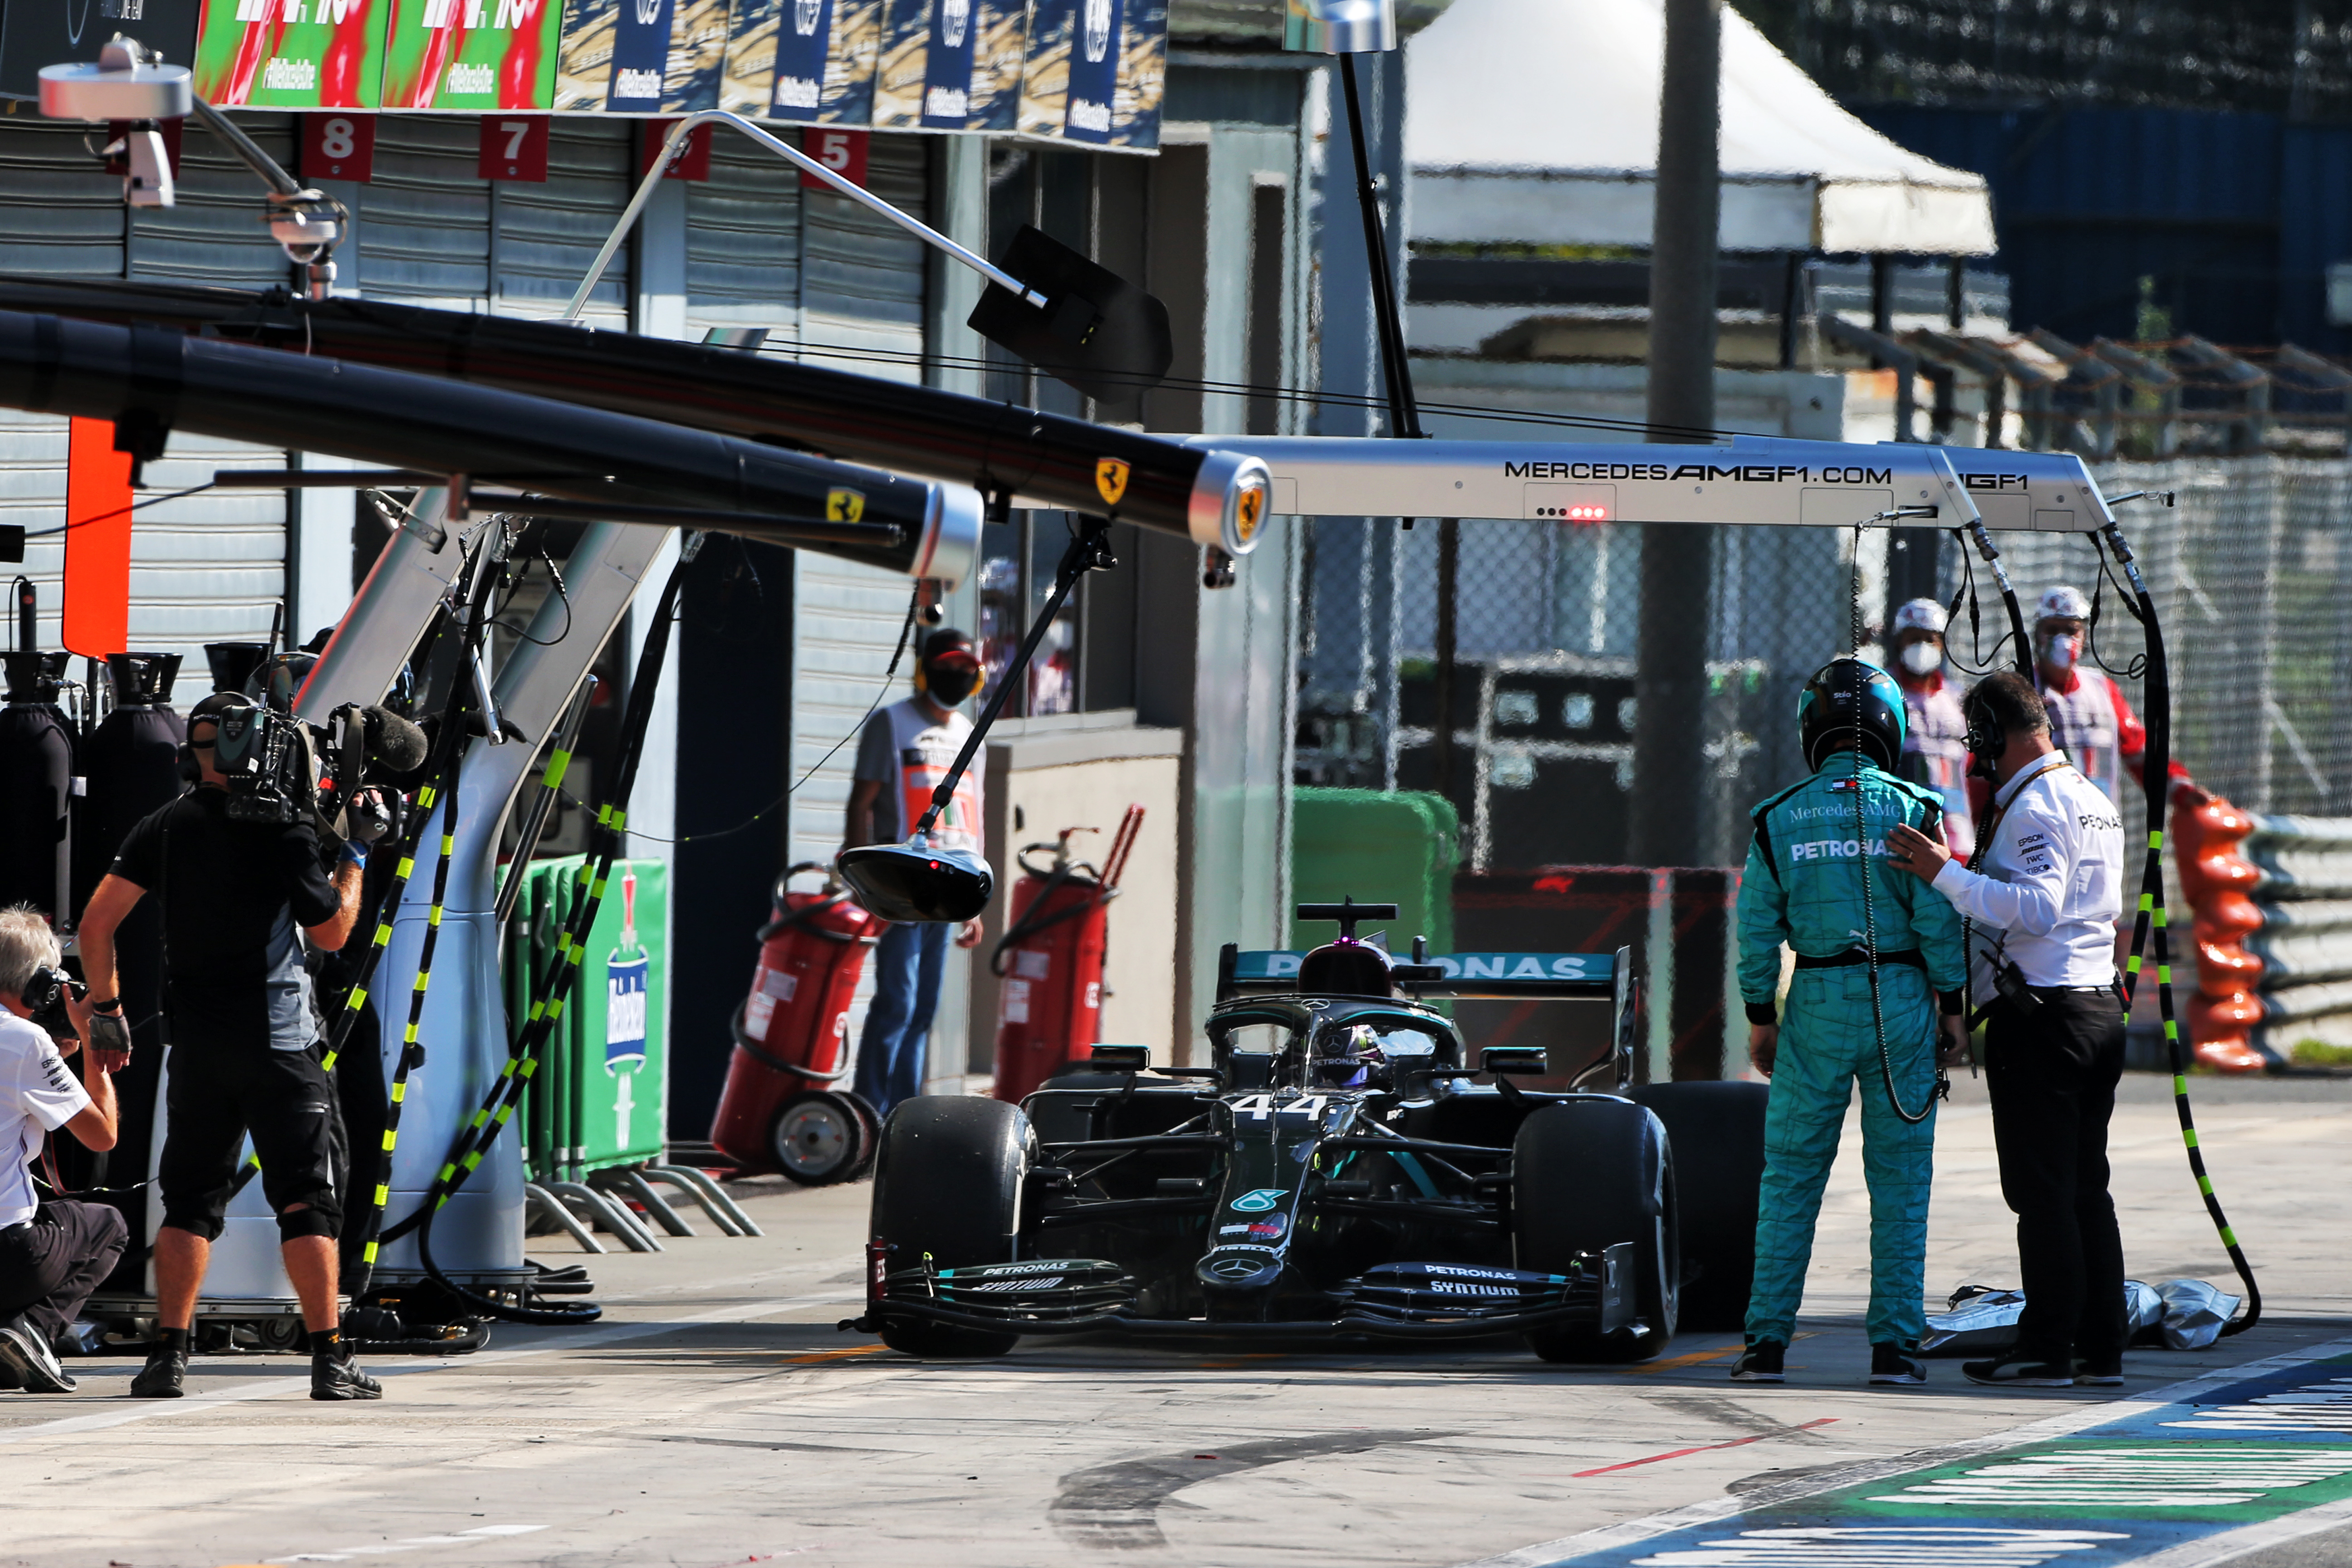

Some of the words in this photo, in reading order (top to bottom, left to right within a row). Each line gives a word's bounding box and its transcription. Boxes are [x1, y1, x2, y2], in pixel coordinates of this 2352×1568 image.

[323, 119, 354, 158] 8
[500, 122, 529, 159] 7
[821, 134, 850, 170] 5
[1504, 461, 1892, 485] MERCEDESAMGF1.COM
[2018, 833, 2044, 847] EPSON
[2025, 854, 2044, 864] IWC
[1231, 1094, 1328, 1121] 44
[983, 1262, 1070, 1275] PETRONAS
[1425, 1265, 1517, 1280] PETRONAS
[1431, 1280, 1520, 1295] SYNTIUM
